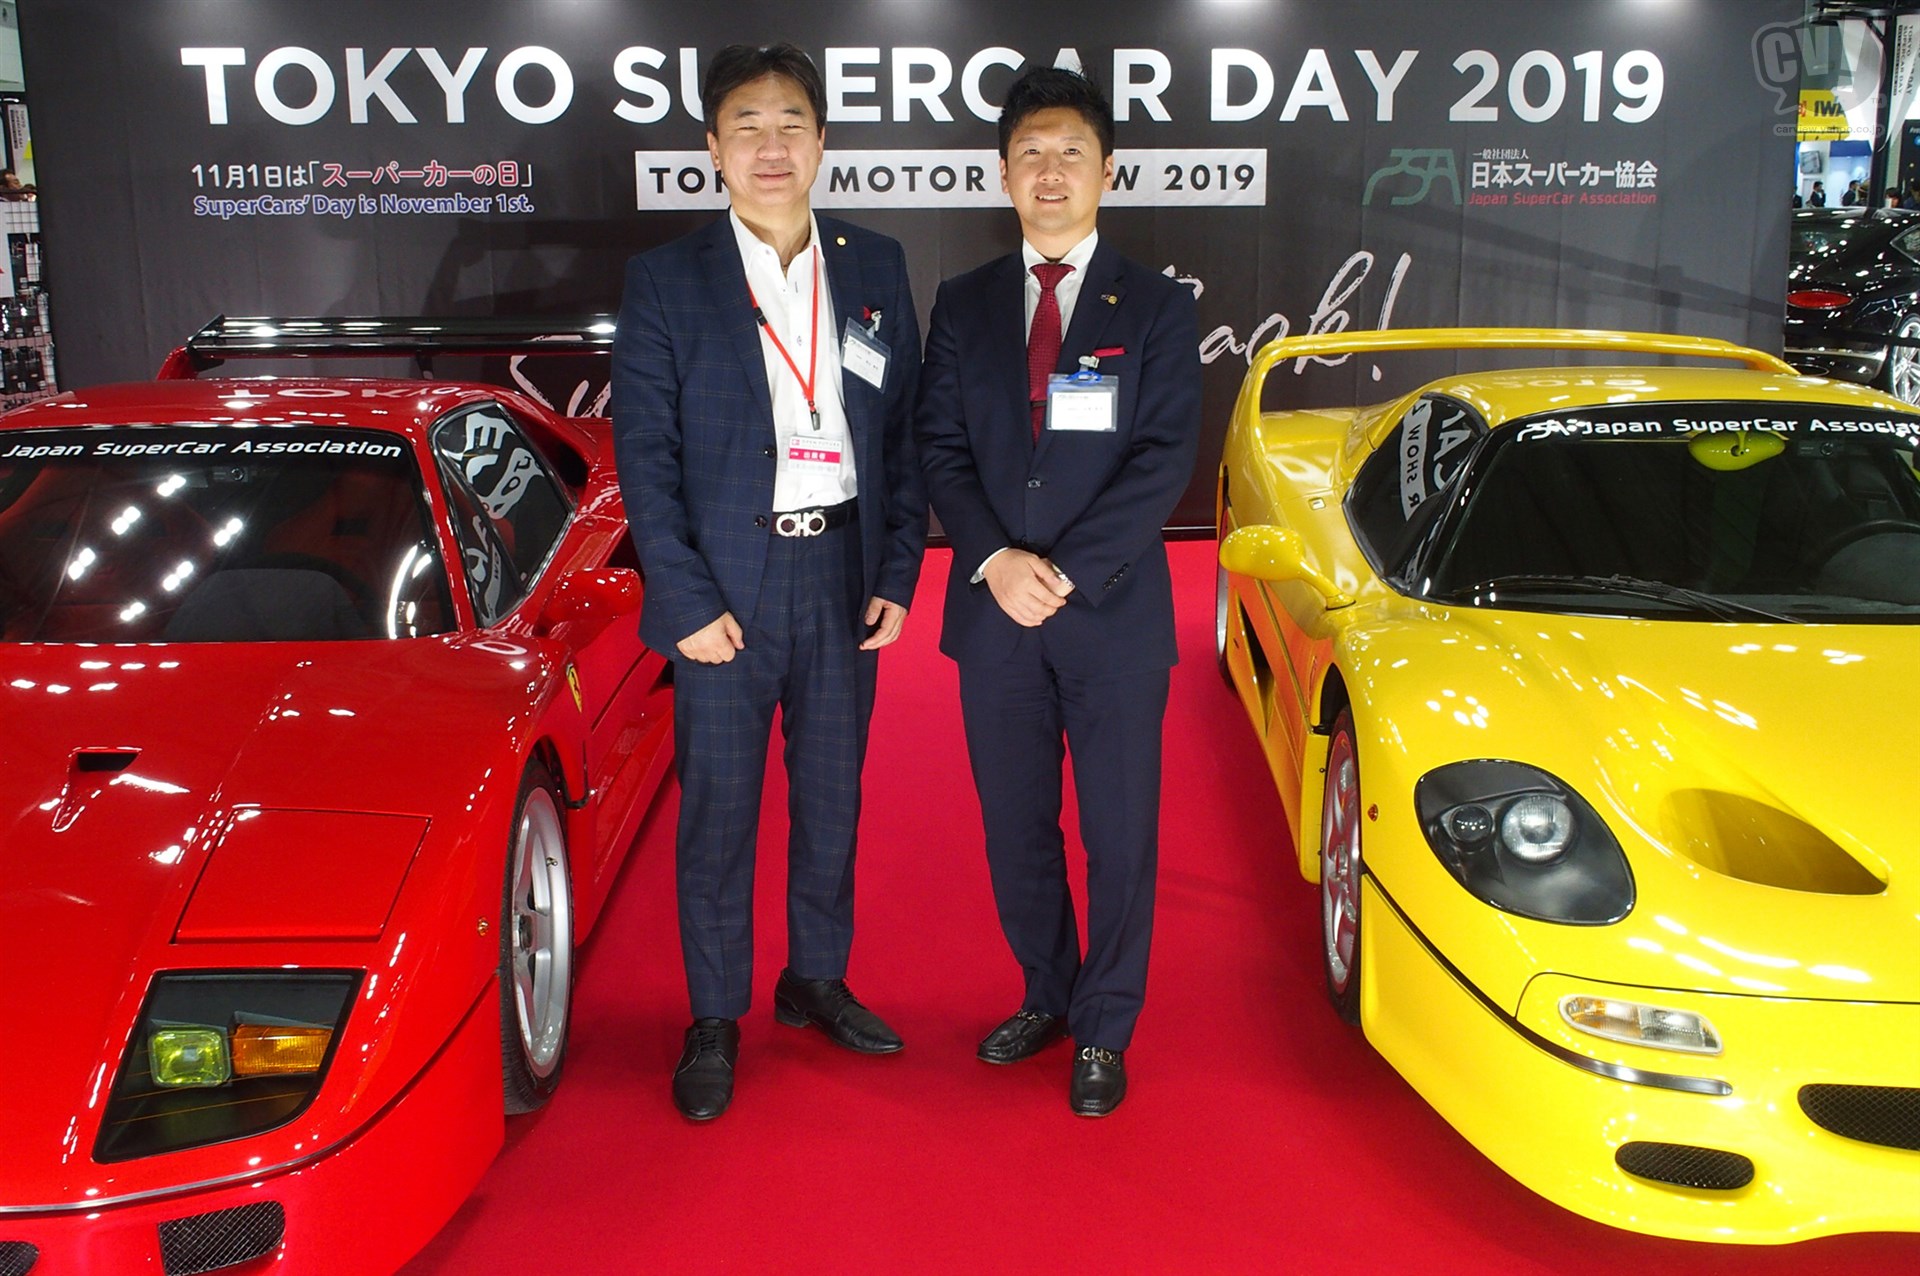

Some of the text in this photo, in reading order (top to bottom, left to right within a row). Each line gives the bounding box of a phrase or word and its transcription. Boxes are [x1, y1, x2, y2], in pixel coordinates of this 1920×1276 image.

[181, 46, 1665, 126] TOKYO SUERCR DAY 2019
[1472, 148, 1530, 160] 一般社団法人
[191, 160, 533, 189] 11月1日は「スーパーカーの日」
[829, 165, 986, 193] MOTOR
[1163, 164, 1255, 191] 2019
[1471, 160, 1658, 188] 日本スーパーカー協会
[312, 195, 356, 220] Day
[358, 194, 379, 214] is
[380, 193, 492, 214] November
[494, 194, 536, 214] 1st.
[1469, 192, 1657, 206] Japan SuperCar Association
[1581, 420, 1661, 436] Japan
[1672, 418, 1798, 434] SuperCar
[1, 440, 402, 459] Japan SuperCar Association
